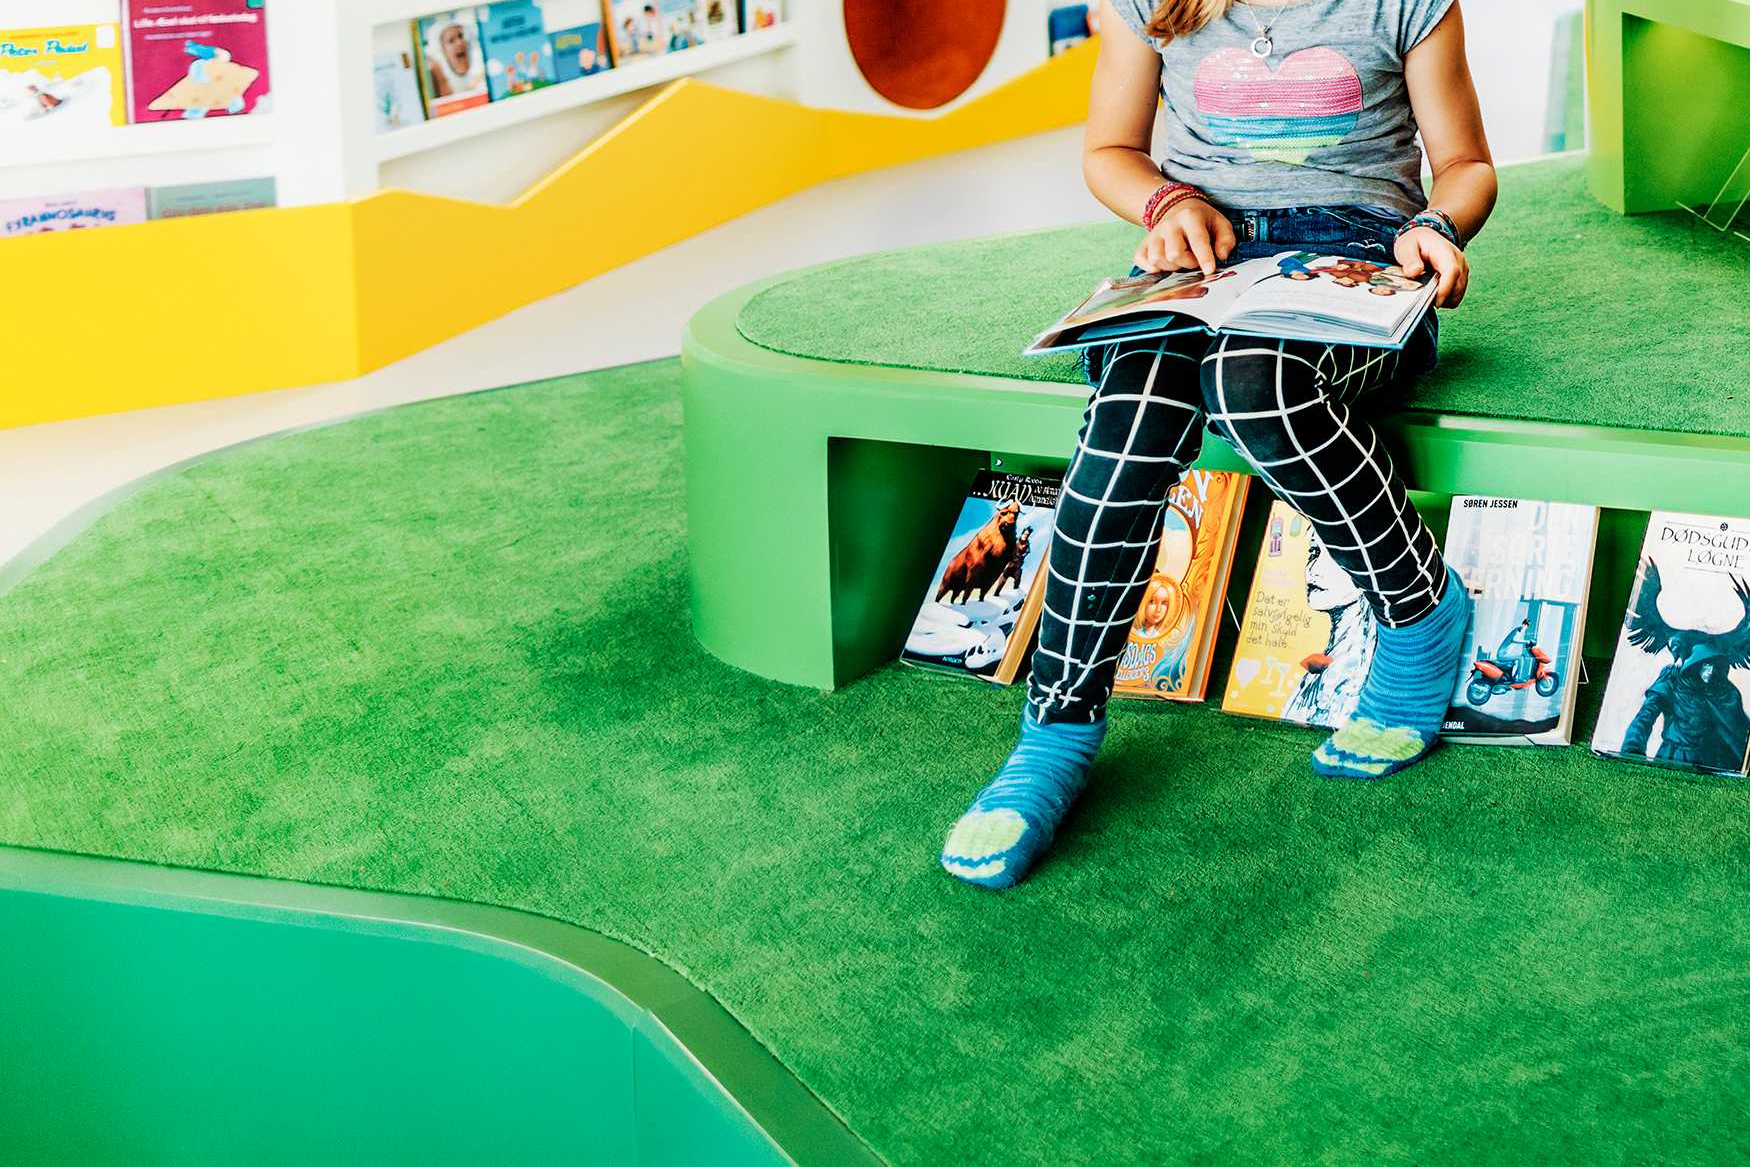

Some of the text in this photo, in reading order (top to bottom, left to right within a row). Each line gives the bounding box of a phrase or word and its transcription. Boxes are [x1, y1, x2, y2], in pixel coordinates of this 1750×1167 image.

[1463, 499, 1519, 509] SØREN JESSEN
[1687, 548, 1745, 570] LØGNE
